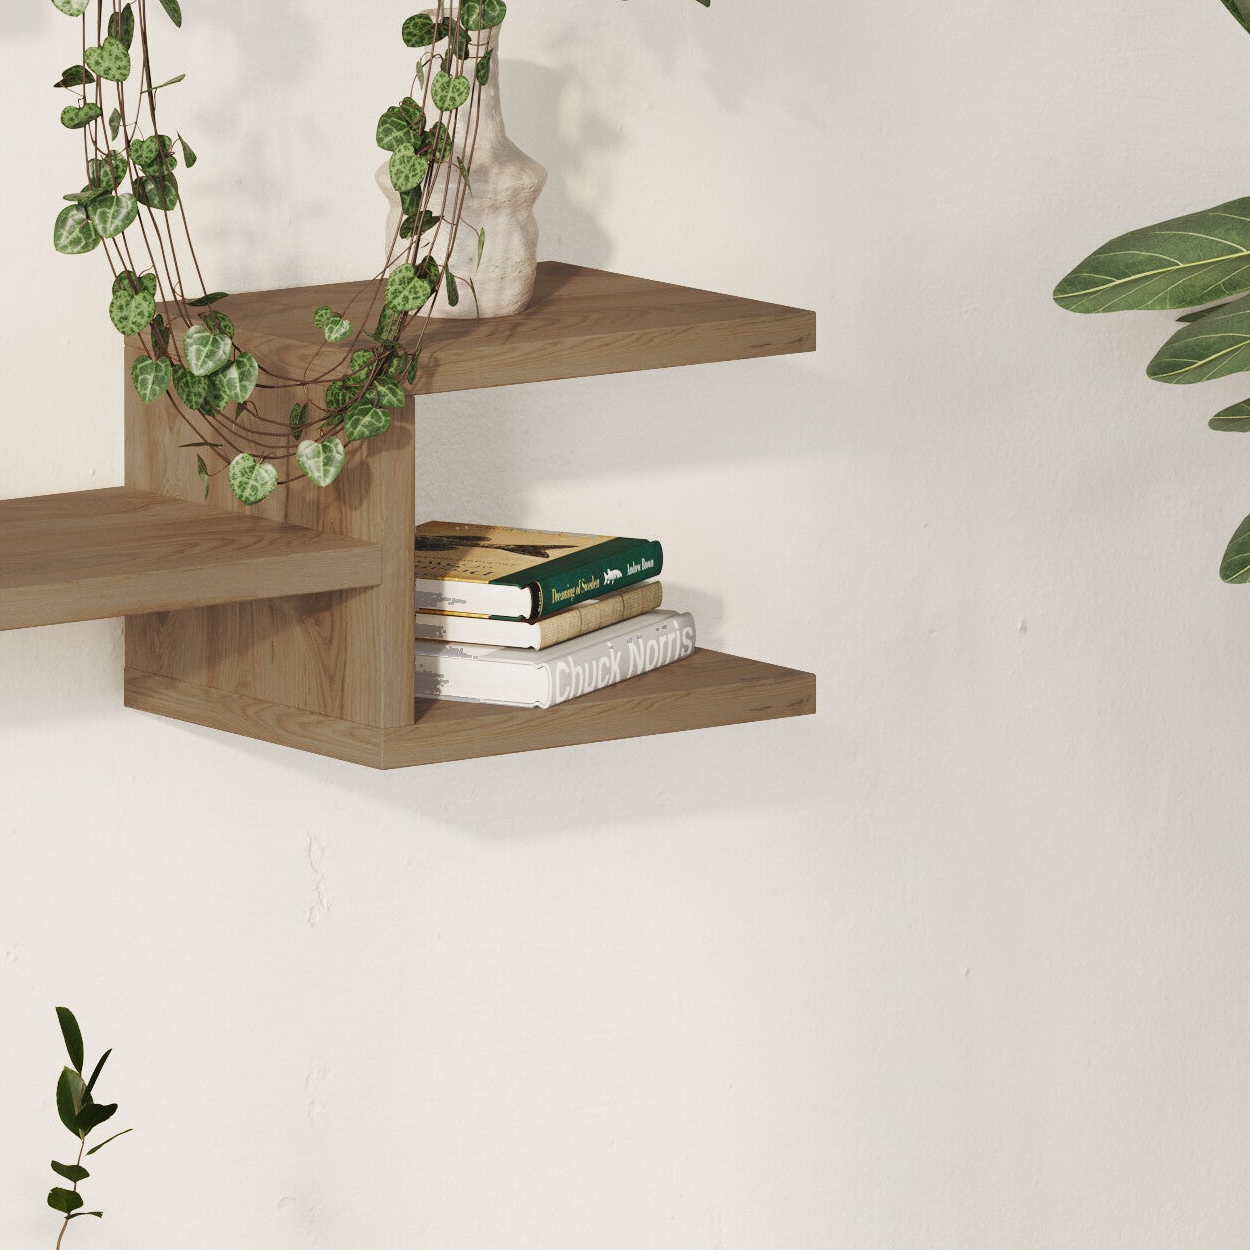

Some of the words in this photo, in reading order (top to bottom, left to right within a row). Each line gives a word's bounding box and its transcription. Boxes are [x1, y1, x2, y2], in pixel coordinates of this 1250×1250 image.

[575, 579, 582, 595] of
[581, 575, 600, 592] Sweden
[555, 642, 622, 702] Chuck
[627, 621, 693, 678] Norris
